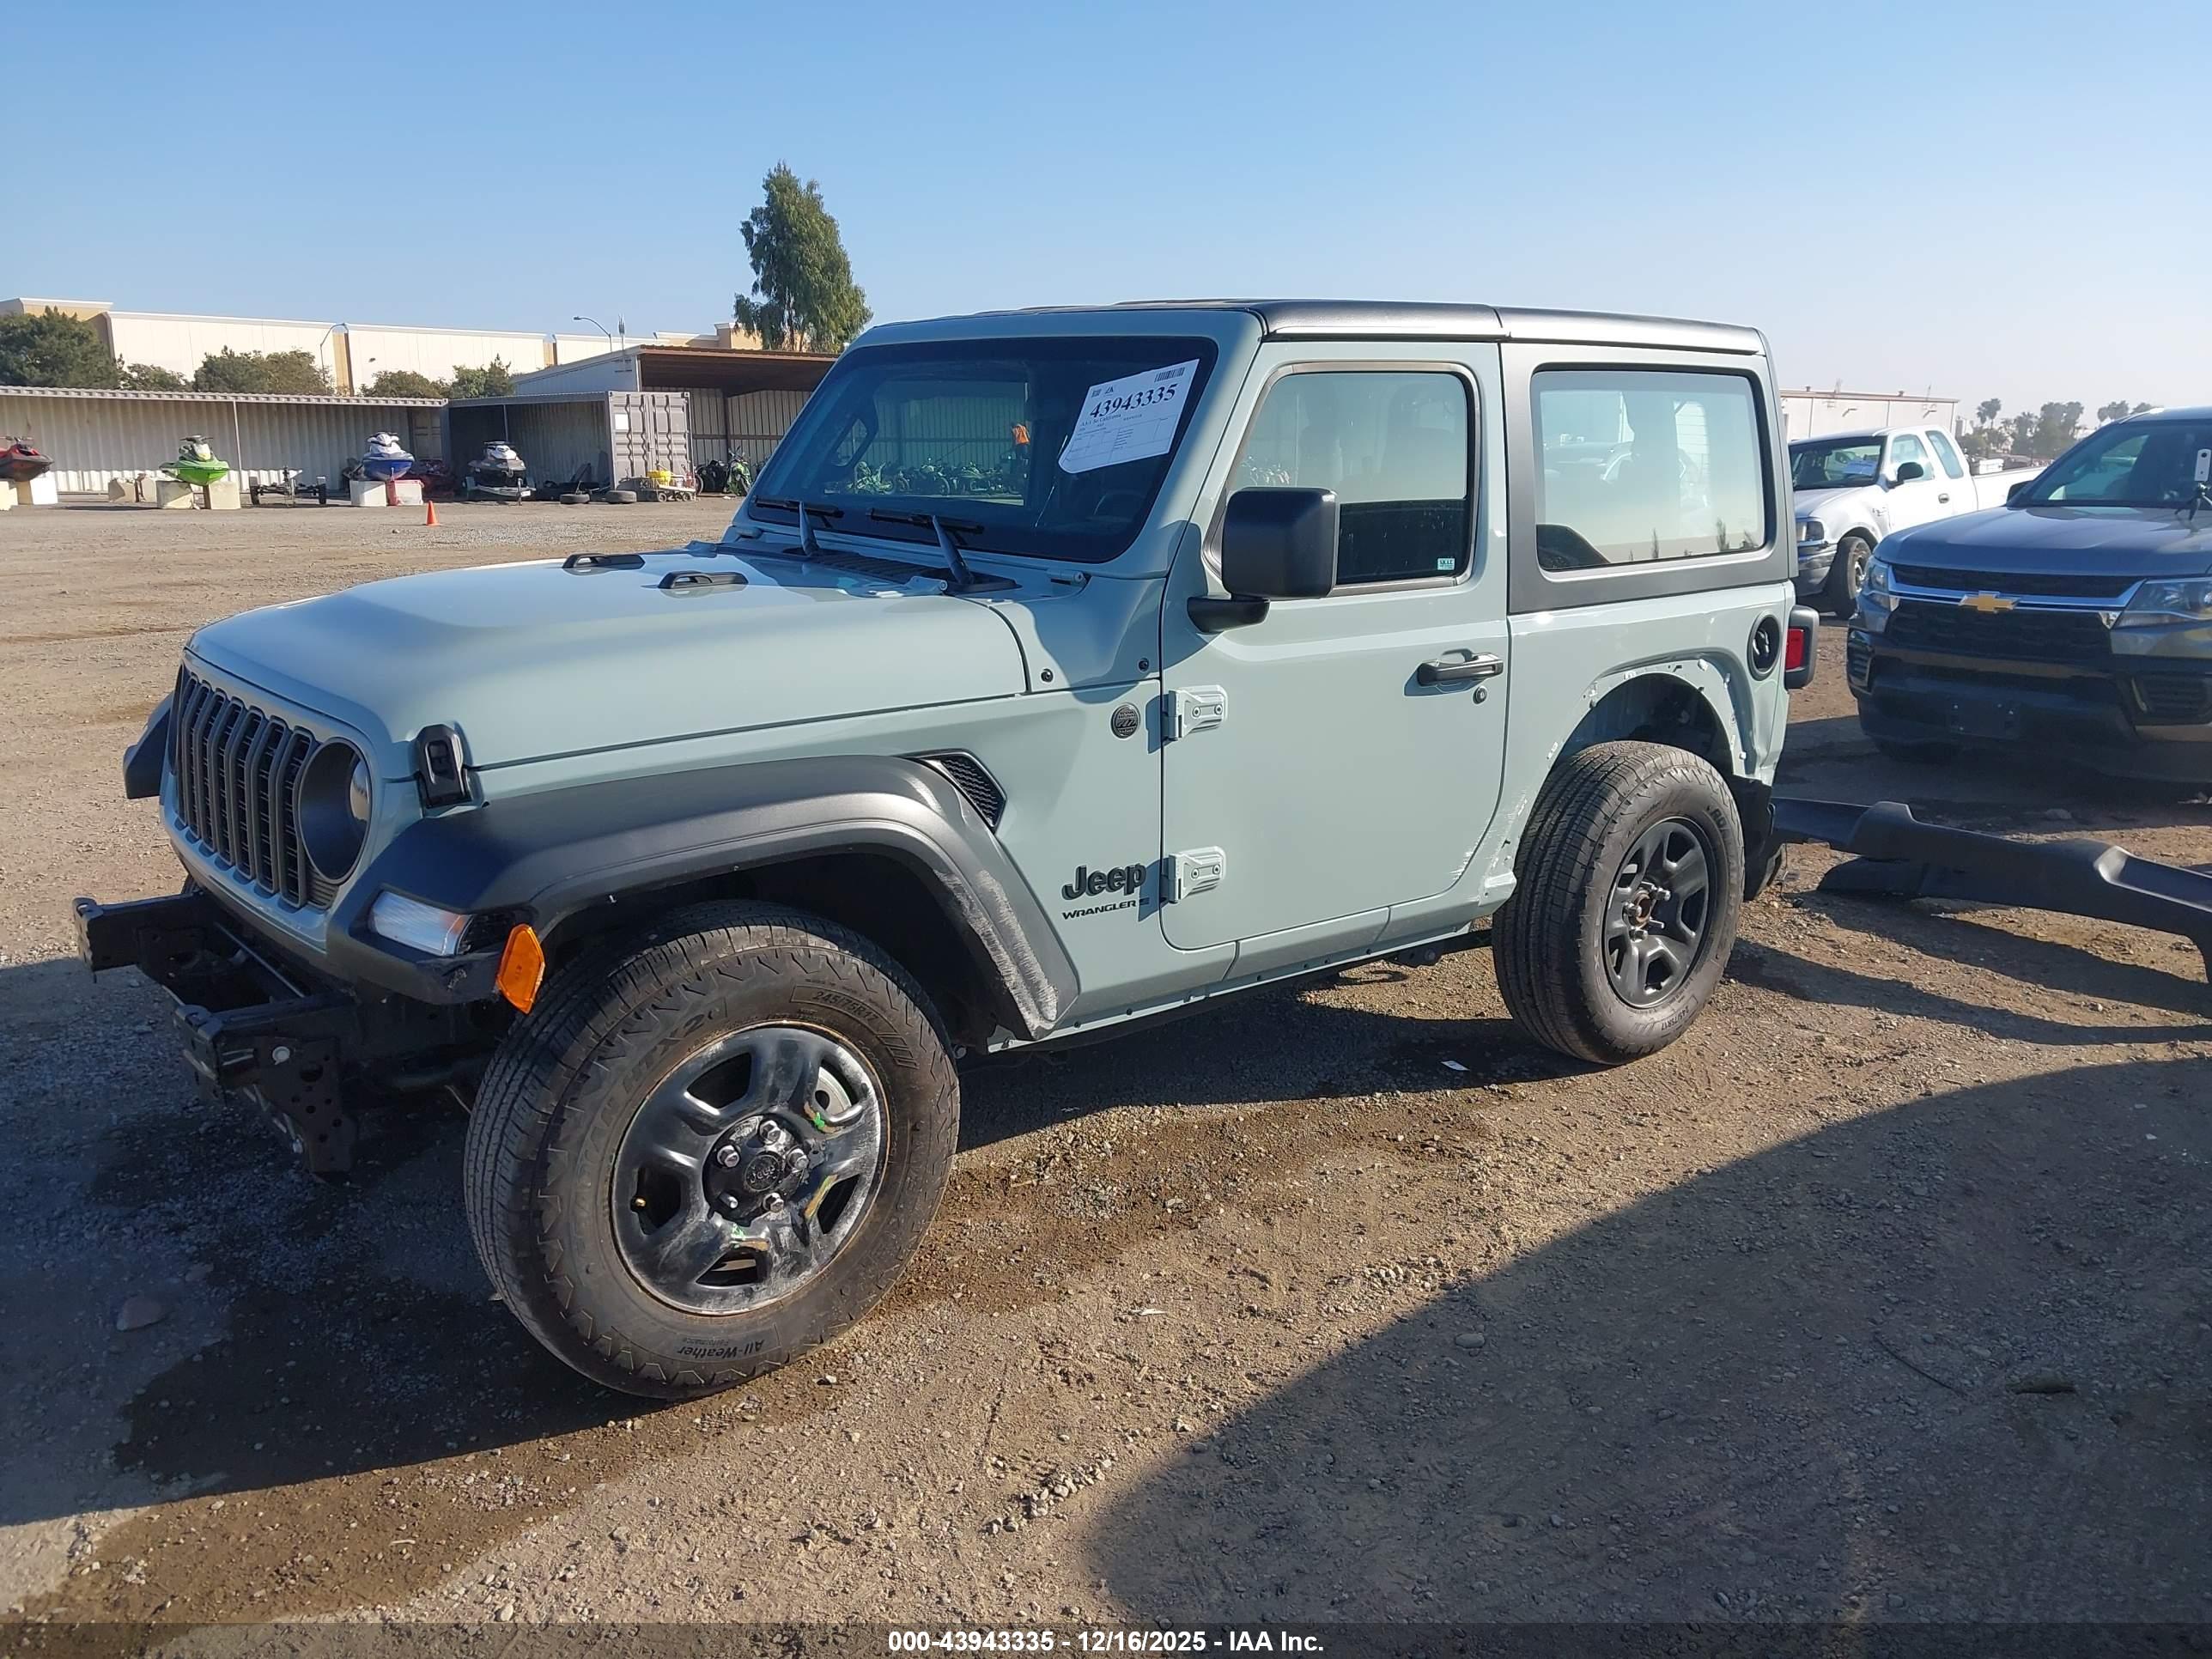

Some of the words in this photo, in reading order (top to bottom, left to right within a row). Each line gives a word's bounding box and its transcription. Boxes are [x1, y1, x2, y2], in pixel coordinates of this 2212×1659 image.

[1089, 383, 1179, 418] 43943335
[1061, 862, 1147, 900] Jeep
[1062, 899, 1137, 921] WRANGLER
[811, 989, 880, 1023] 245/75R17
[675, 1338, 766, 1359] All-Weather
